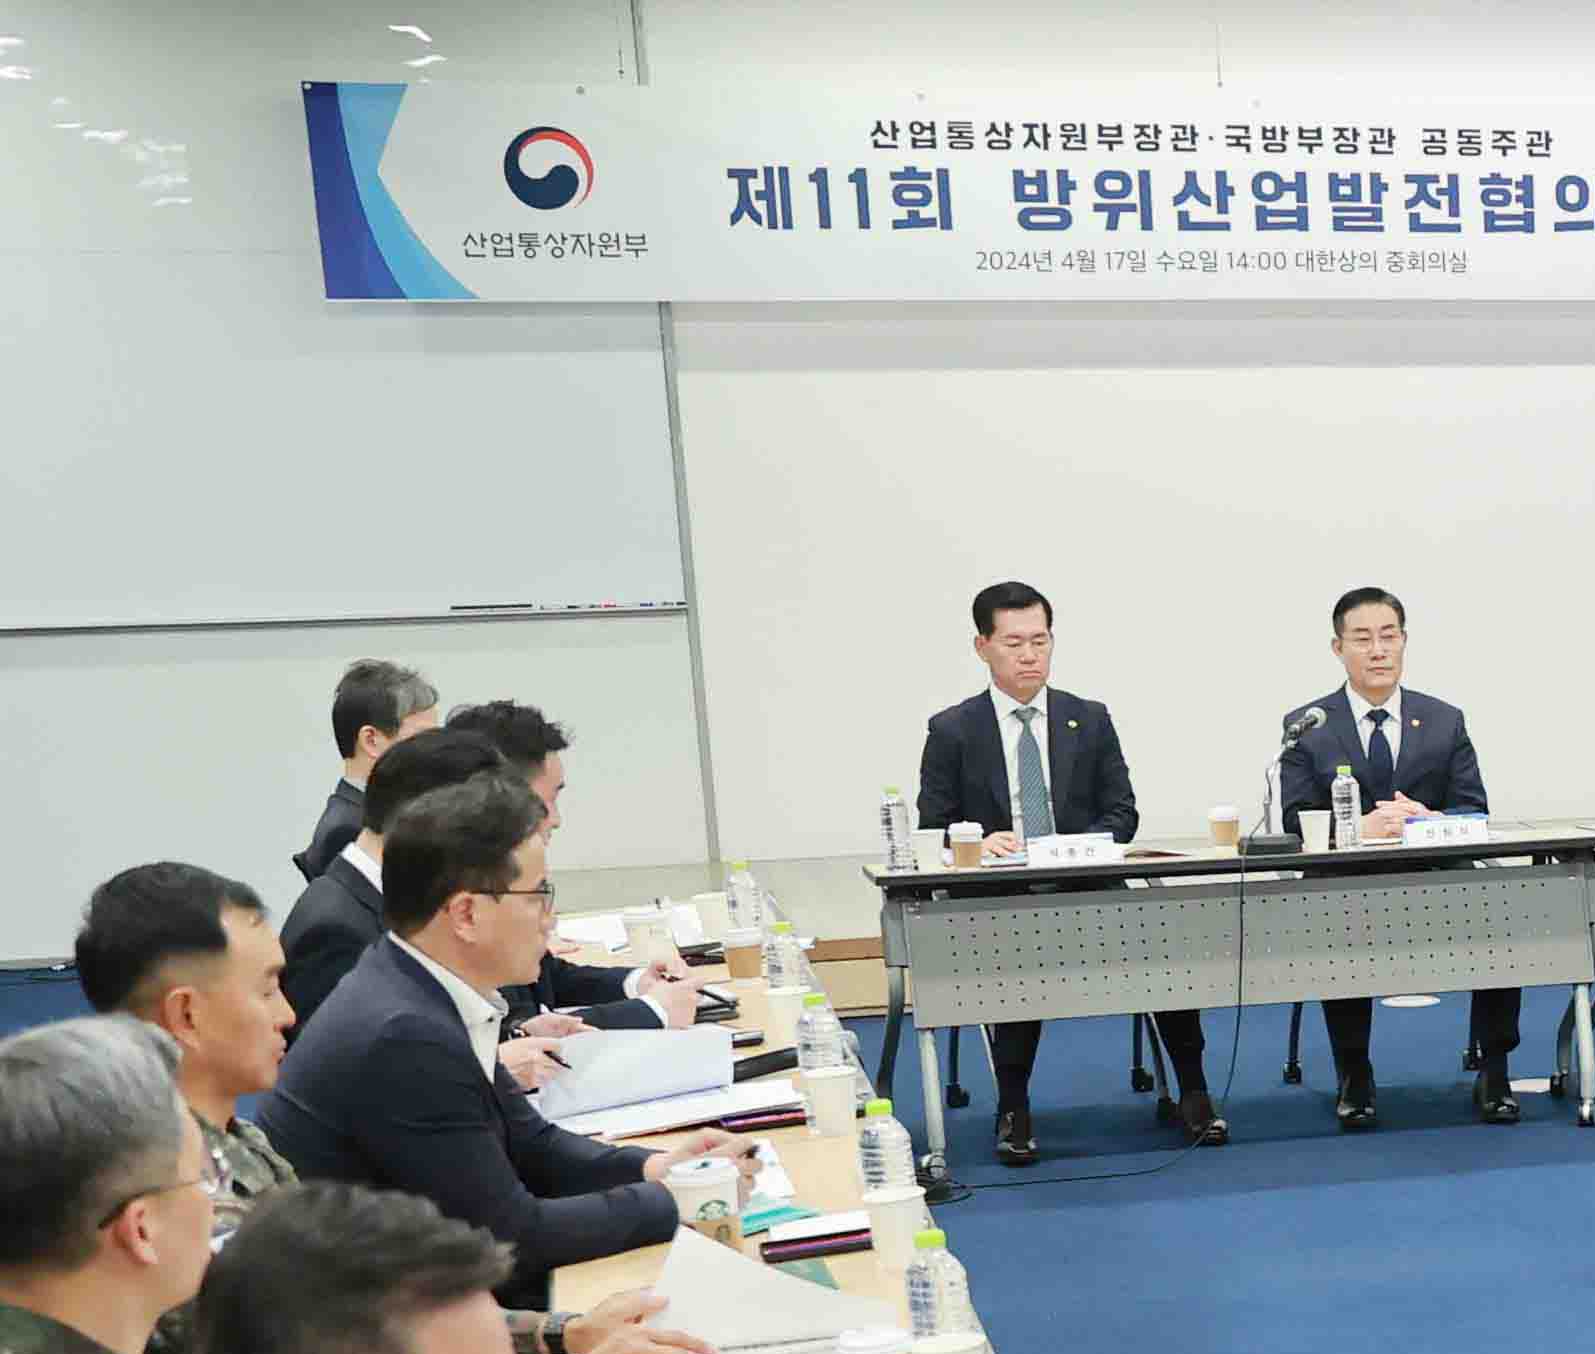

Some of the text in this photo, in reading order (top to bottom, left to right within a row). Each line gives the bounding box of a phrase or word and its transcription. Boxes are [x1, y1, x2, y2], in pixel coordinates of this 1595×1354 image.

[1420, 127, 1554, 159] 공동주관
[726, 165, 954, 232] 제11회
[462, 231, 649, 260] 산업통상자원부
[975, 248, 1467, 274] 2024년 4월 17일 수요일 14:00 대한상의 중회의실
